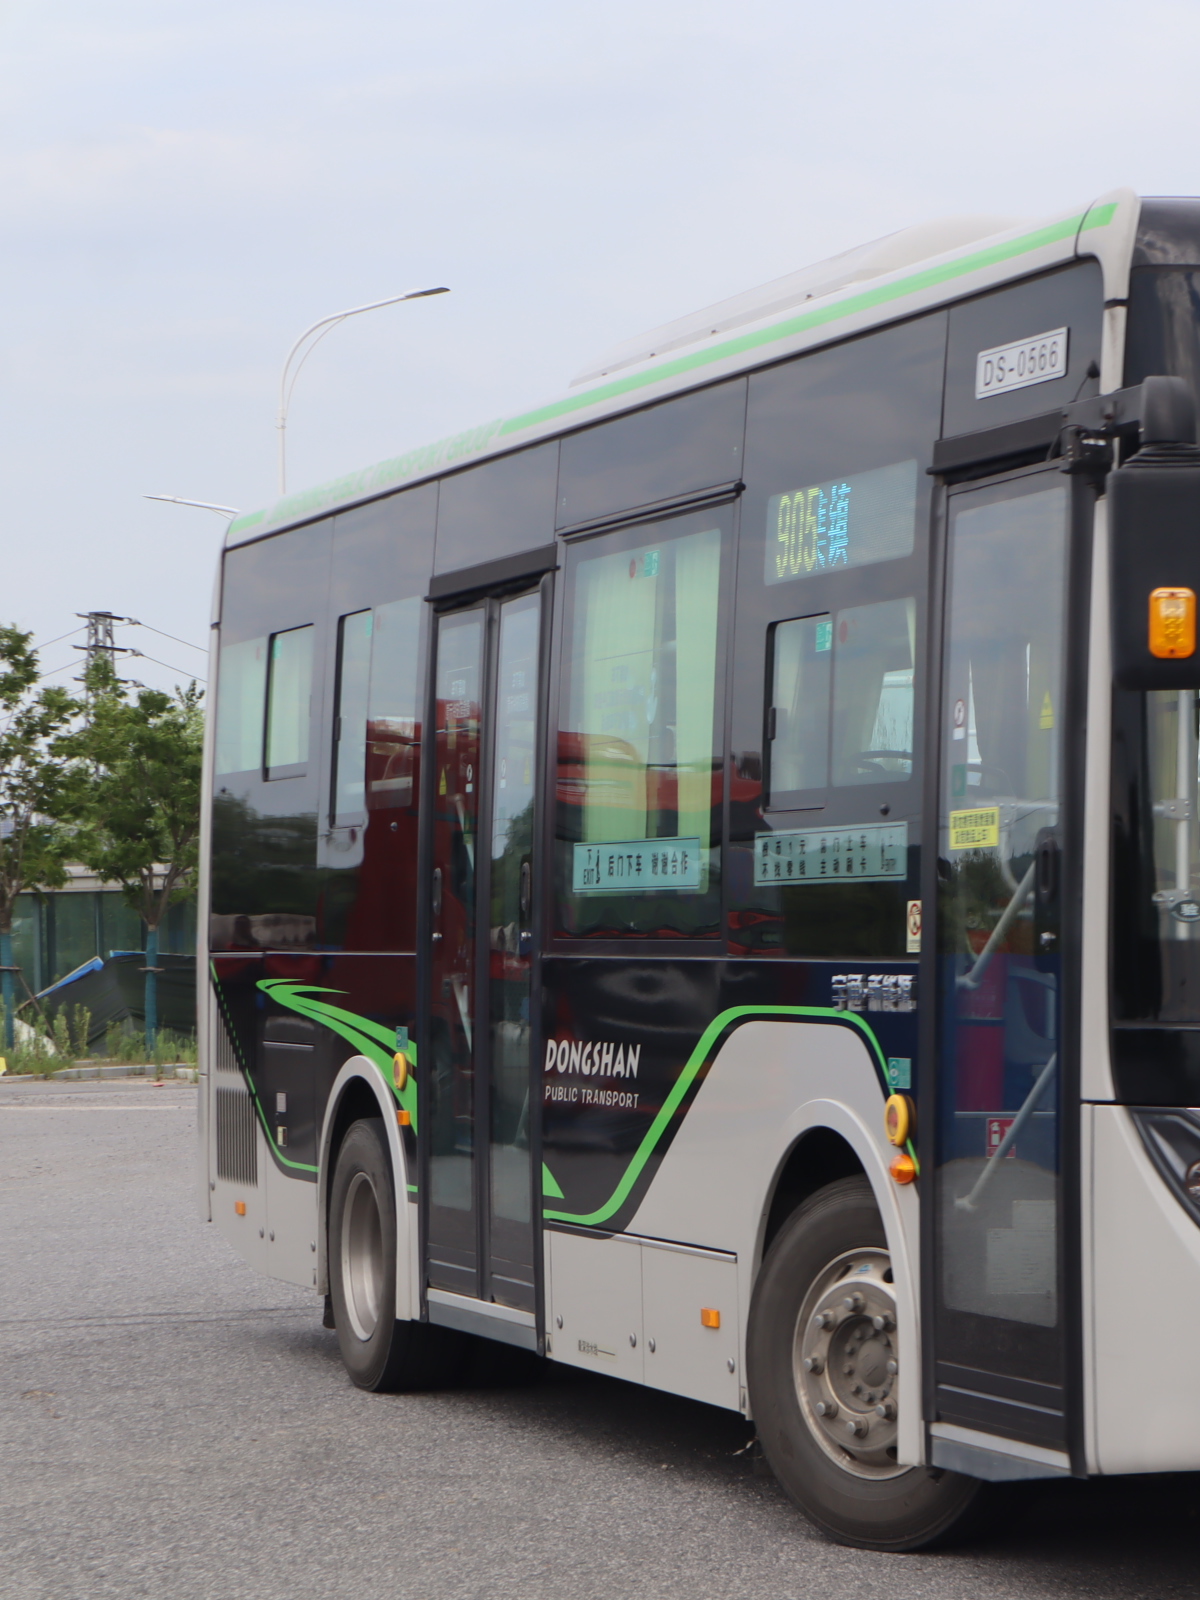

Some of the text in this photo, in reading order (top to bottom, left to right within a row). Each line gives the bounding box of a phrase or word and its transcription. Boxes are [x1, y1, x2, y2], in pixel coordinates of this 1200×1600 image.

[983, 340, 1059, 387] DS-0566
[776, 487, 820, 578] 905
[607, 850, 689, 877] 后门下车 谢谢合作
[544, 1038, 641, 1079] DONGSHAN
[544, 1085, 640, 1109] PUBLIC TRANSPORT
